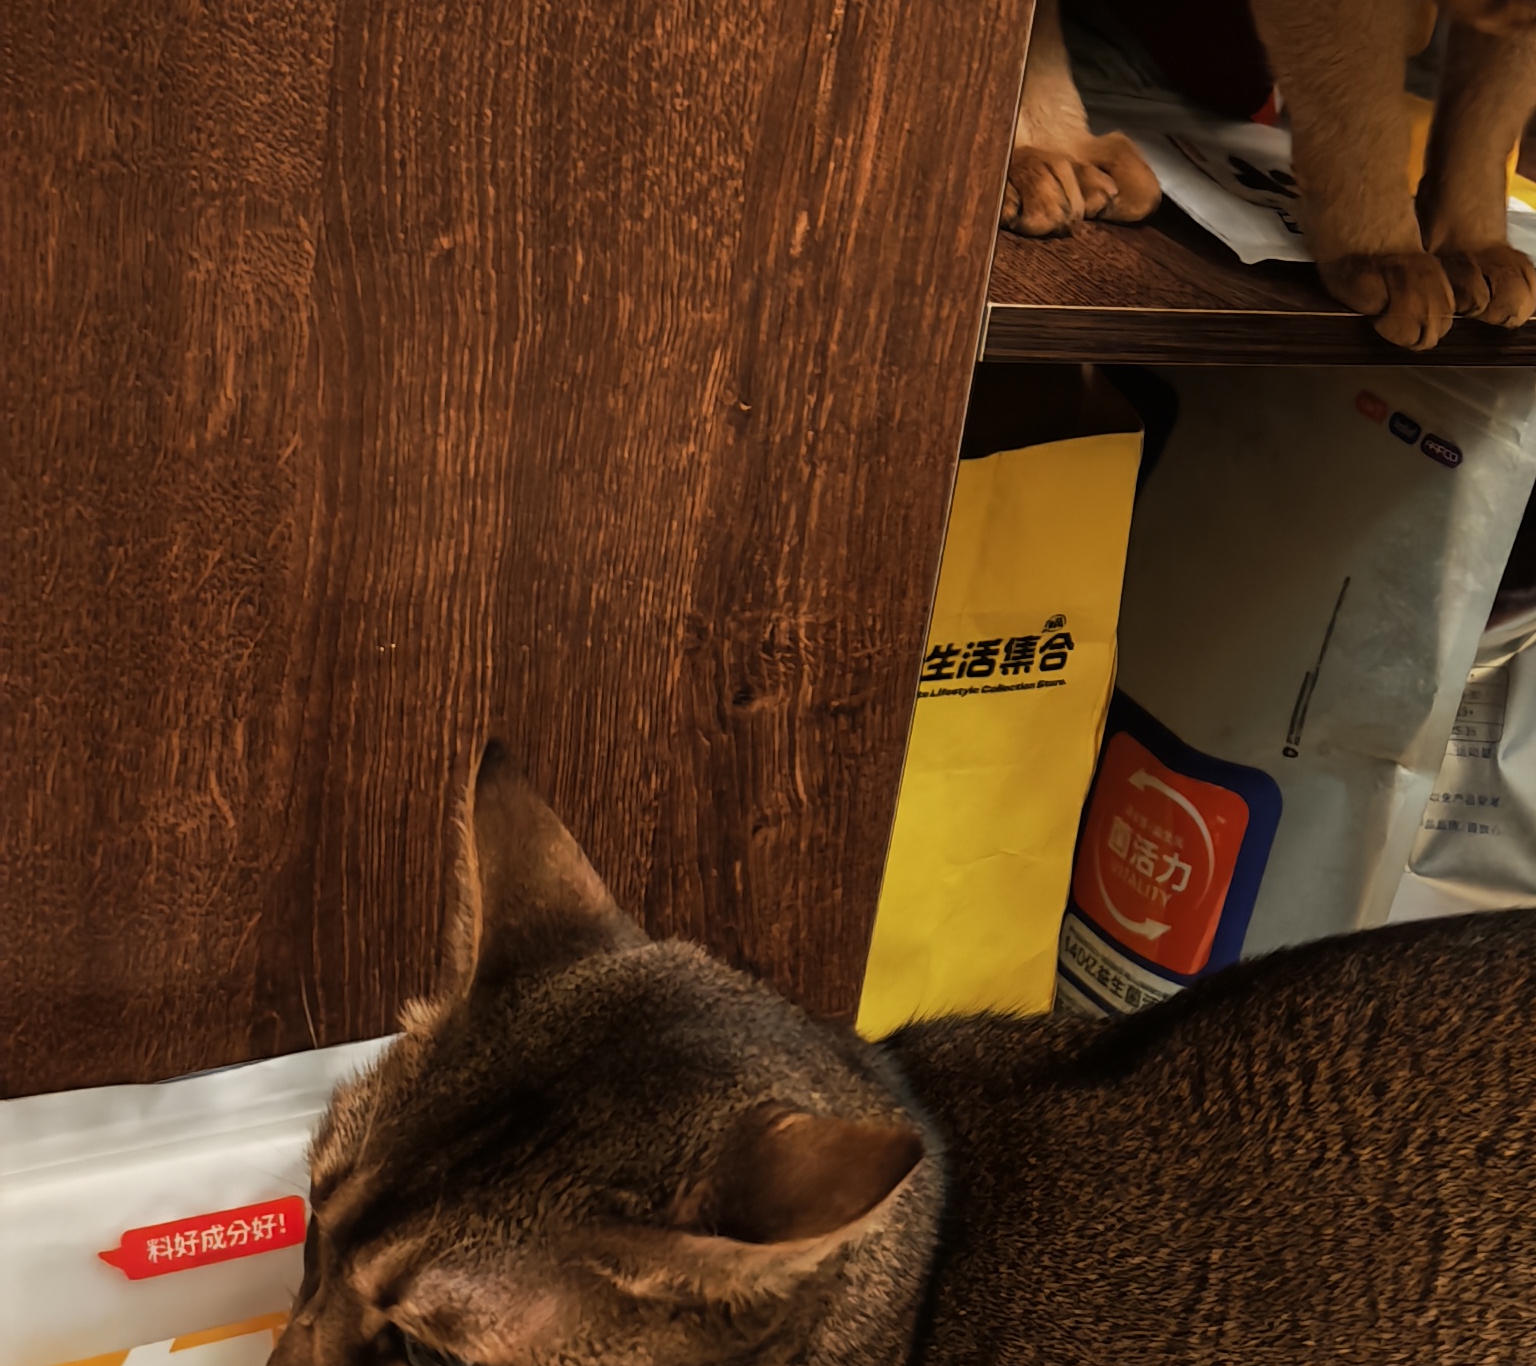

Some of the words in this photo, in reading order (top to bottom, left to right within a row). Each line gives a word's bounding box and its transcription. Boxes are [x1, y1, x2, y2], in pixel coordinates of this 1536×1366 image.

[920, 632, 1074, 682] 生活集合
[930, 685, 979, 698] Lifestyle
[981, 680, 1036, 695] Collection
